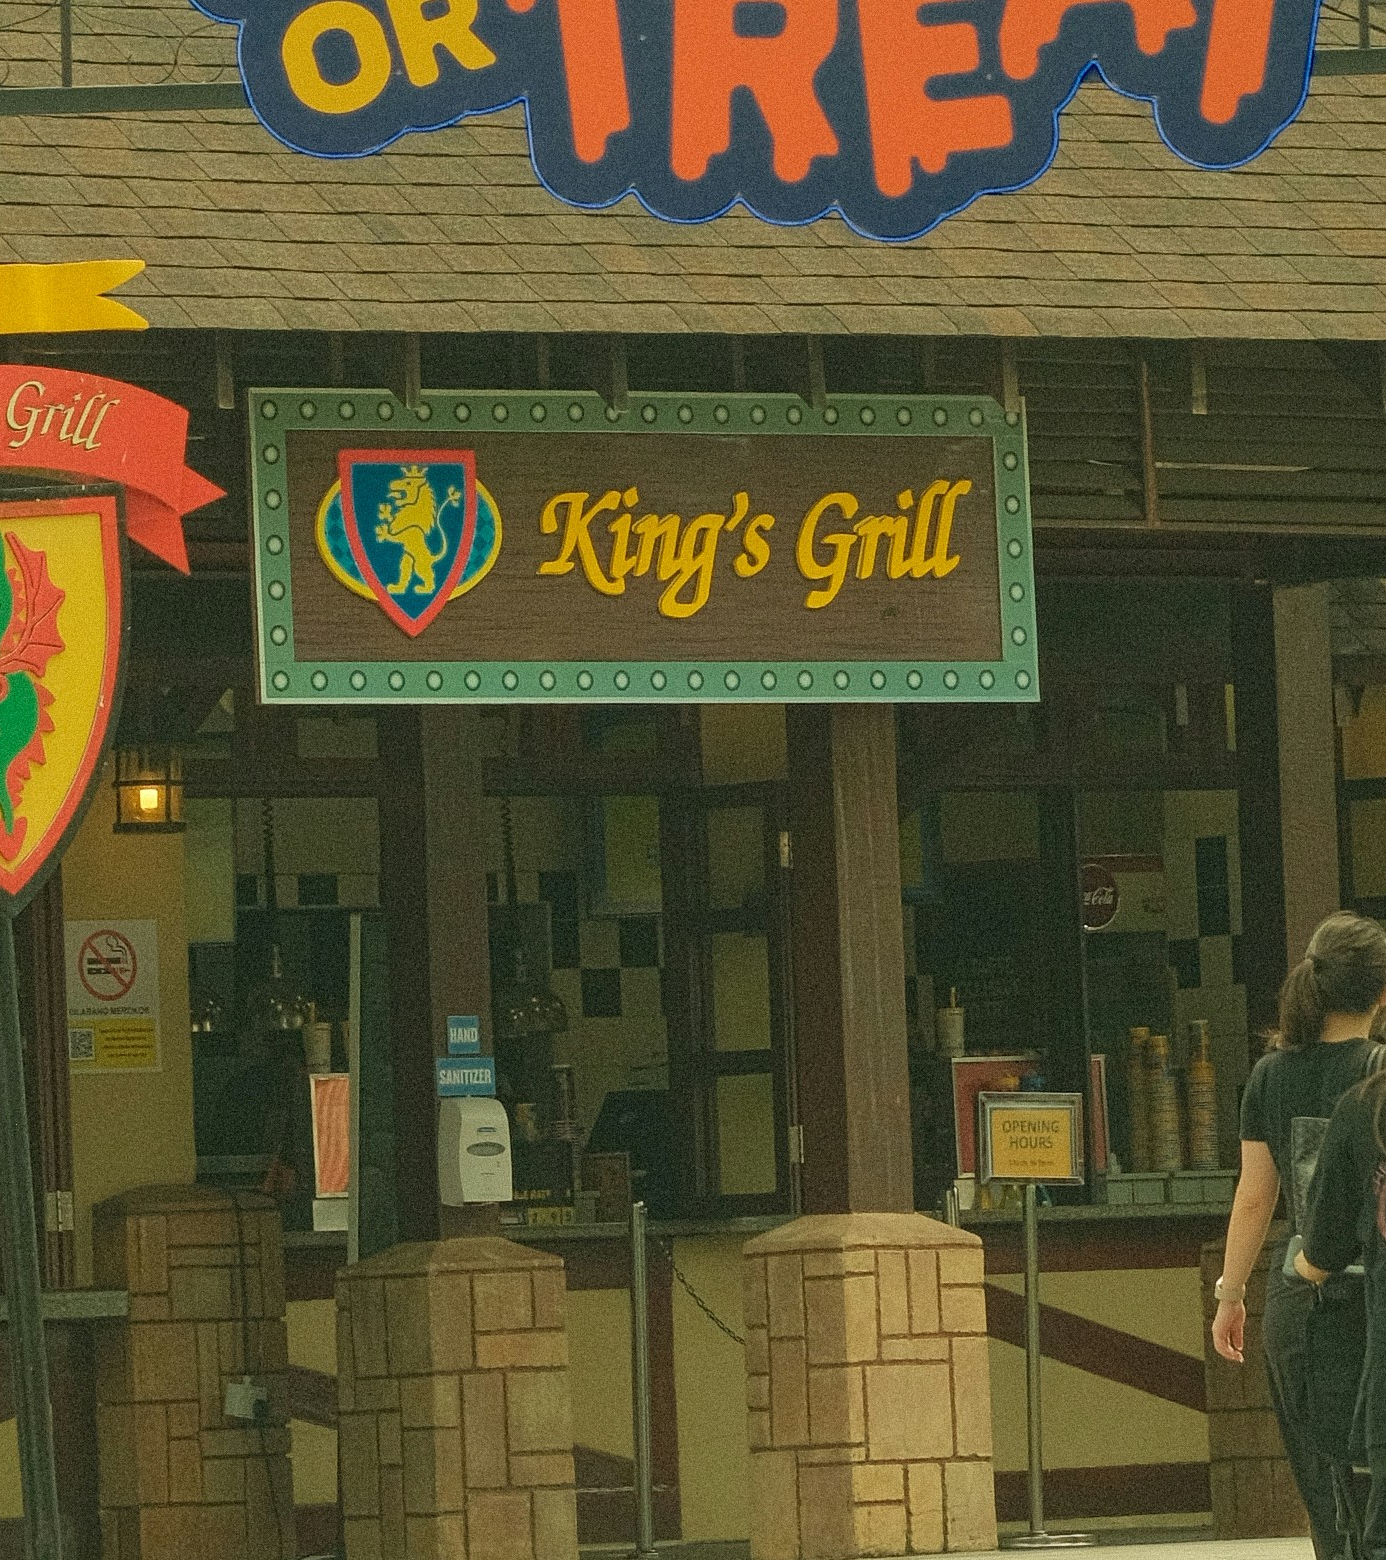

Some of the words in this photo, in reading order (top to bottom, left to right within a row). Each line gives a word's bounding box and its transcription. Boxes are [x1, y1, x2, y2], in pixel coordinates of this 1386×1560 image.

[6, 380, 121, 452] Grill
[539, 491, 777, 619] King's
[796, 479, 974, 610] Grill
[449, 1027, 479, 1043] HAND
[439, 1069, 492, 1085] SANITIZER
[1002, 1120, 1059, 1133] OPENING
[1009, 1135, 1053, 1149] HOURS
